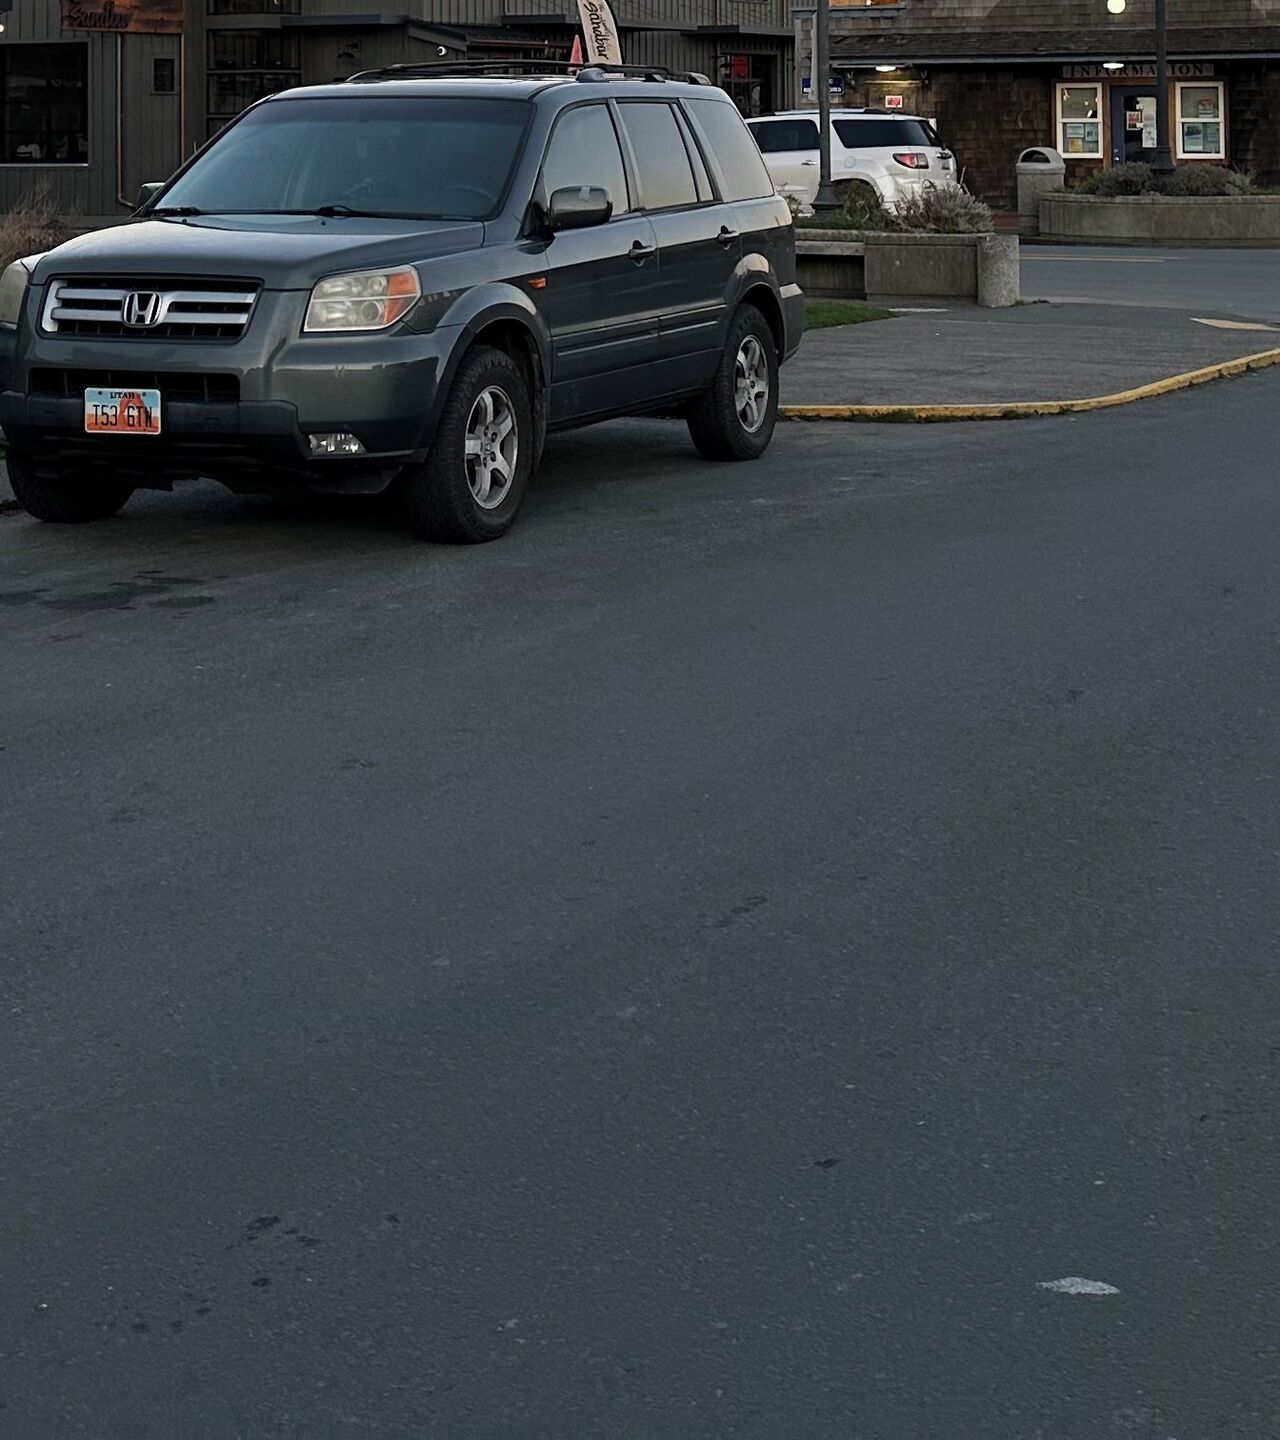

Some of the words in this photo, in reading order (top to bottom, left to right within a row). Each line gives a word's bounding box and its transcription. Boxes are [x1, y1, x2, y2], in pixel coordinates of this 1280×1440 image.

[583, 1, 610, 61] Sandbar
[1070, 63, 1204, 77] INFORMAION
[92, 404, 118, 427] T53
